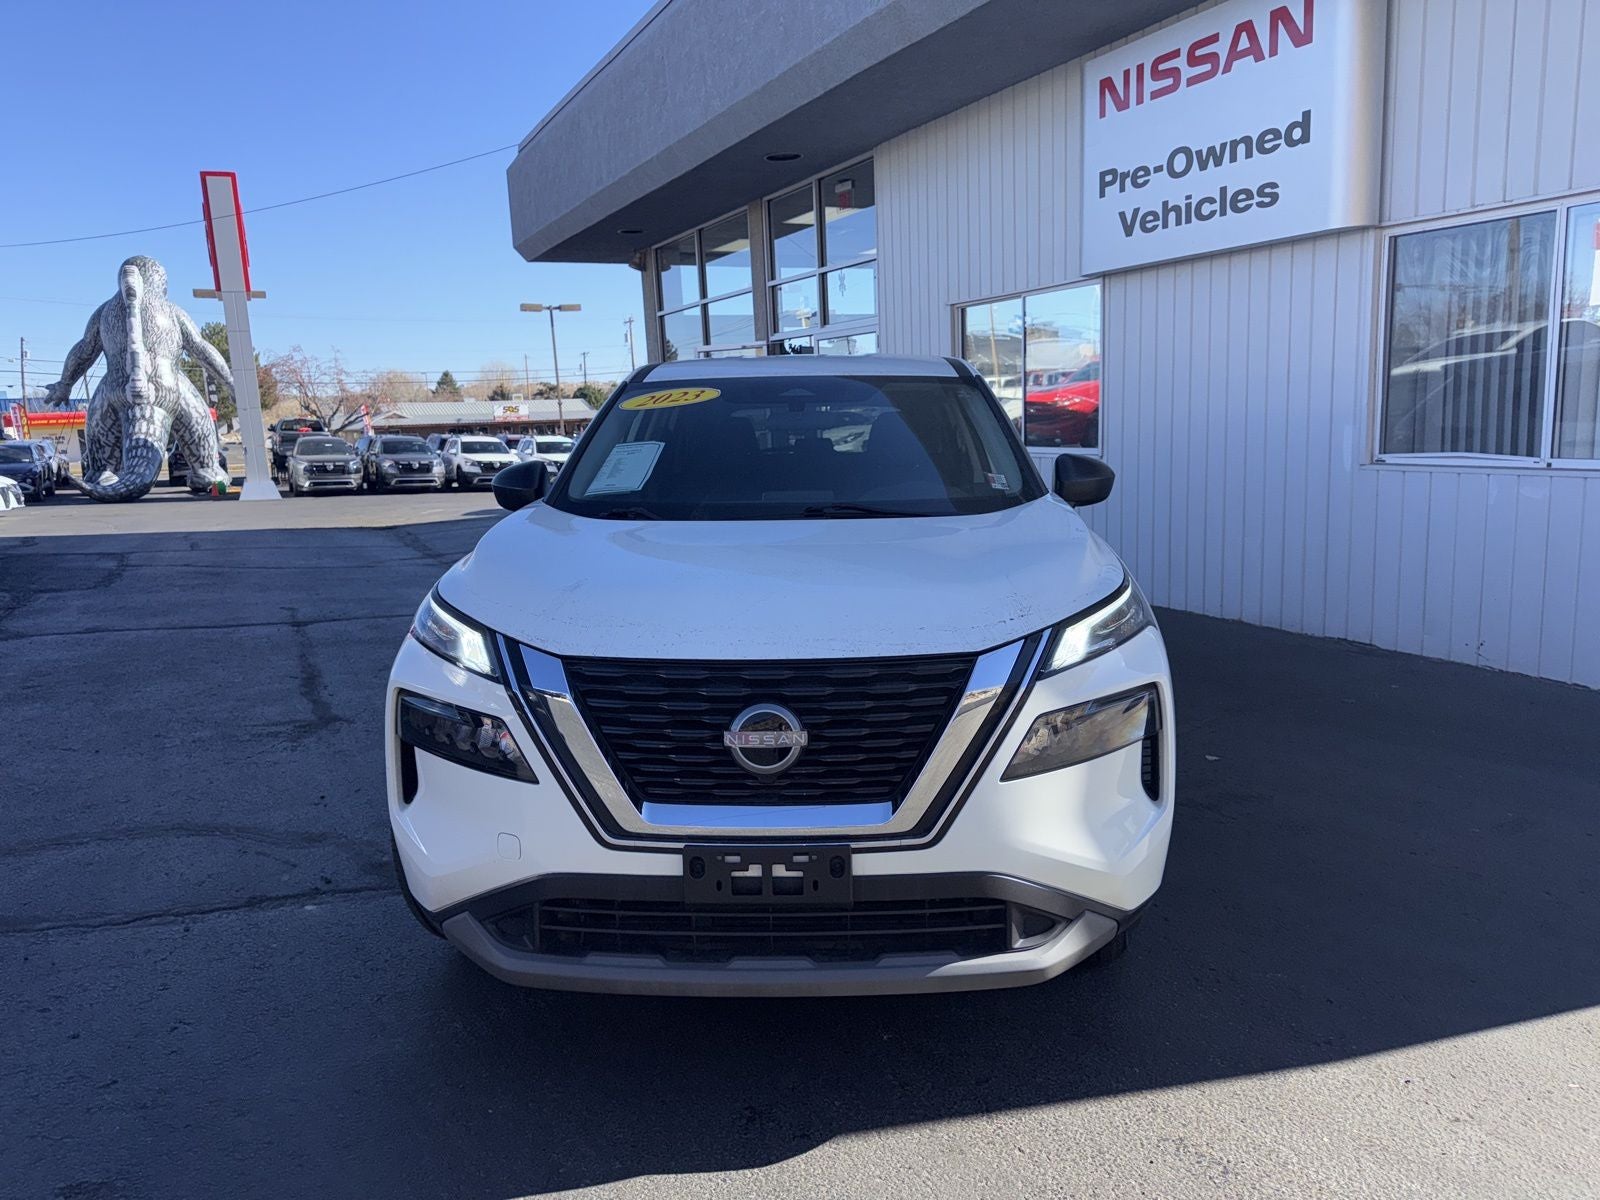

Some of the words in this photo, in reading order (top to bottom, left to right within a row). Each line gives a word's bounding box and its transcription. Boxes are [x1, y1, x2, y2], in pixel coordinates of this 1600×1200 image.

[1099, 0, 1315, 119] NISSAN
[1099, 109, 1312, 199] Pre-Owned
[1118, 181, 1280, 238] Vehicles
[634, 389, 706, 408] 2023
[725, 734, 805, 746] NISSAN
